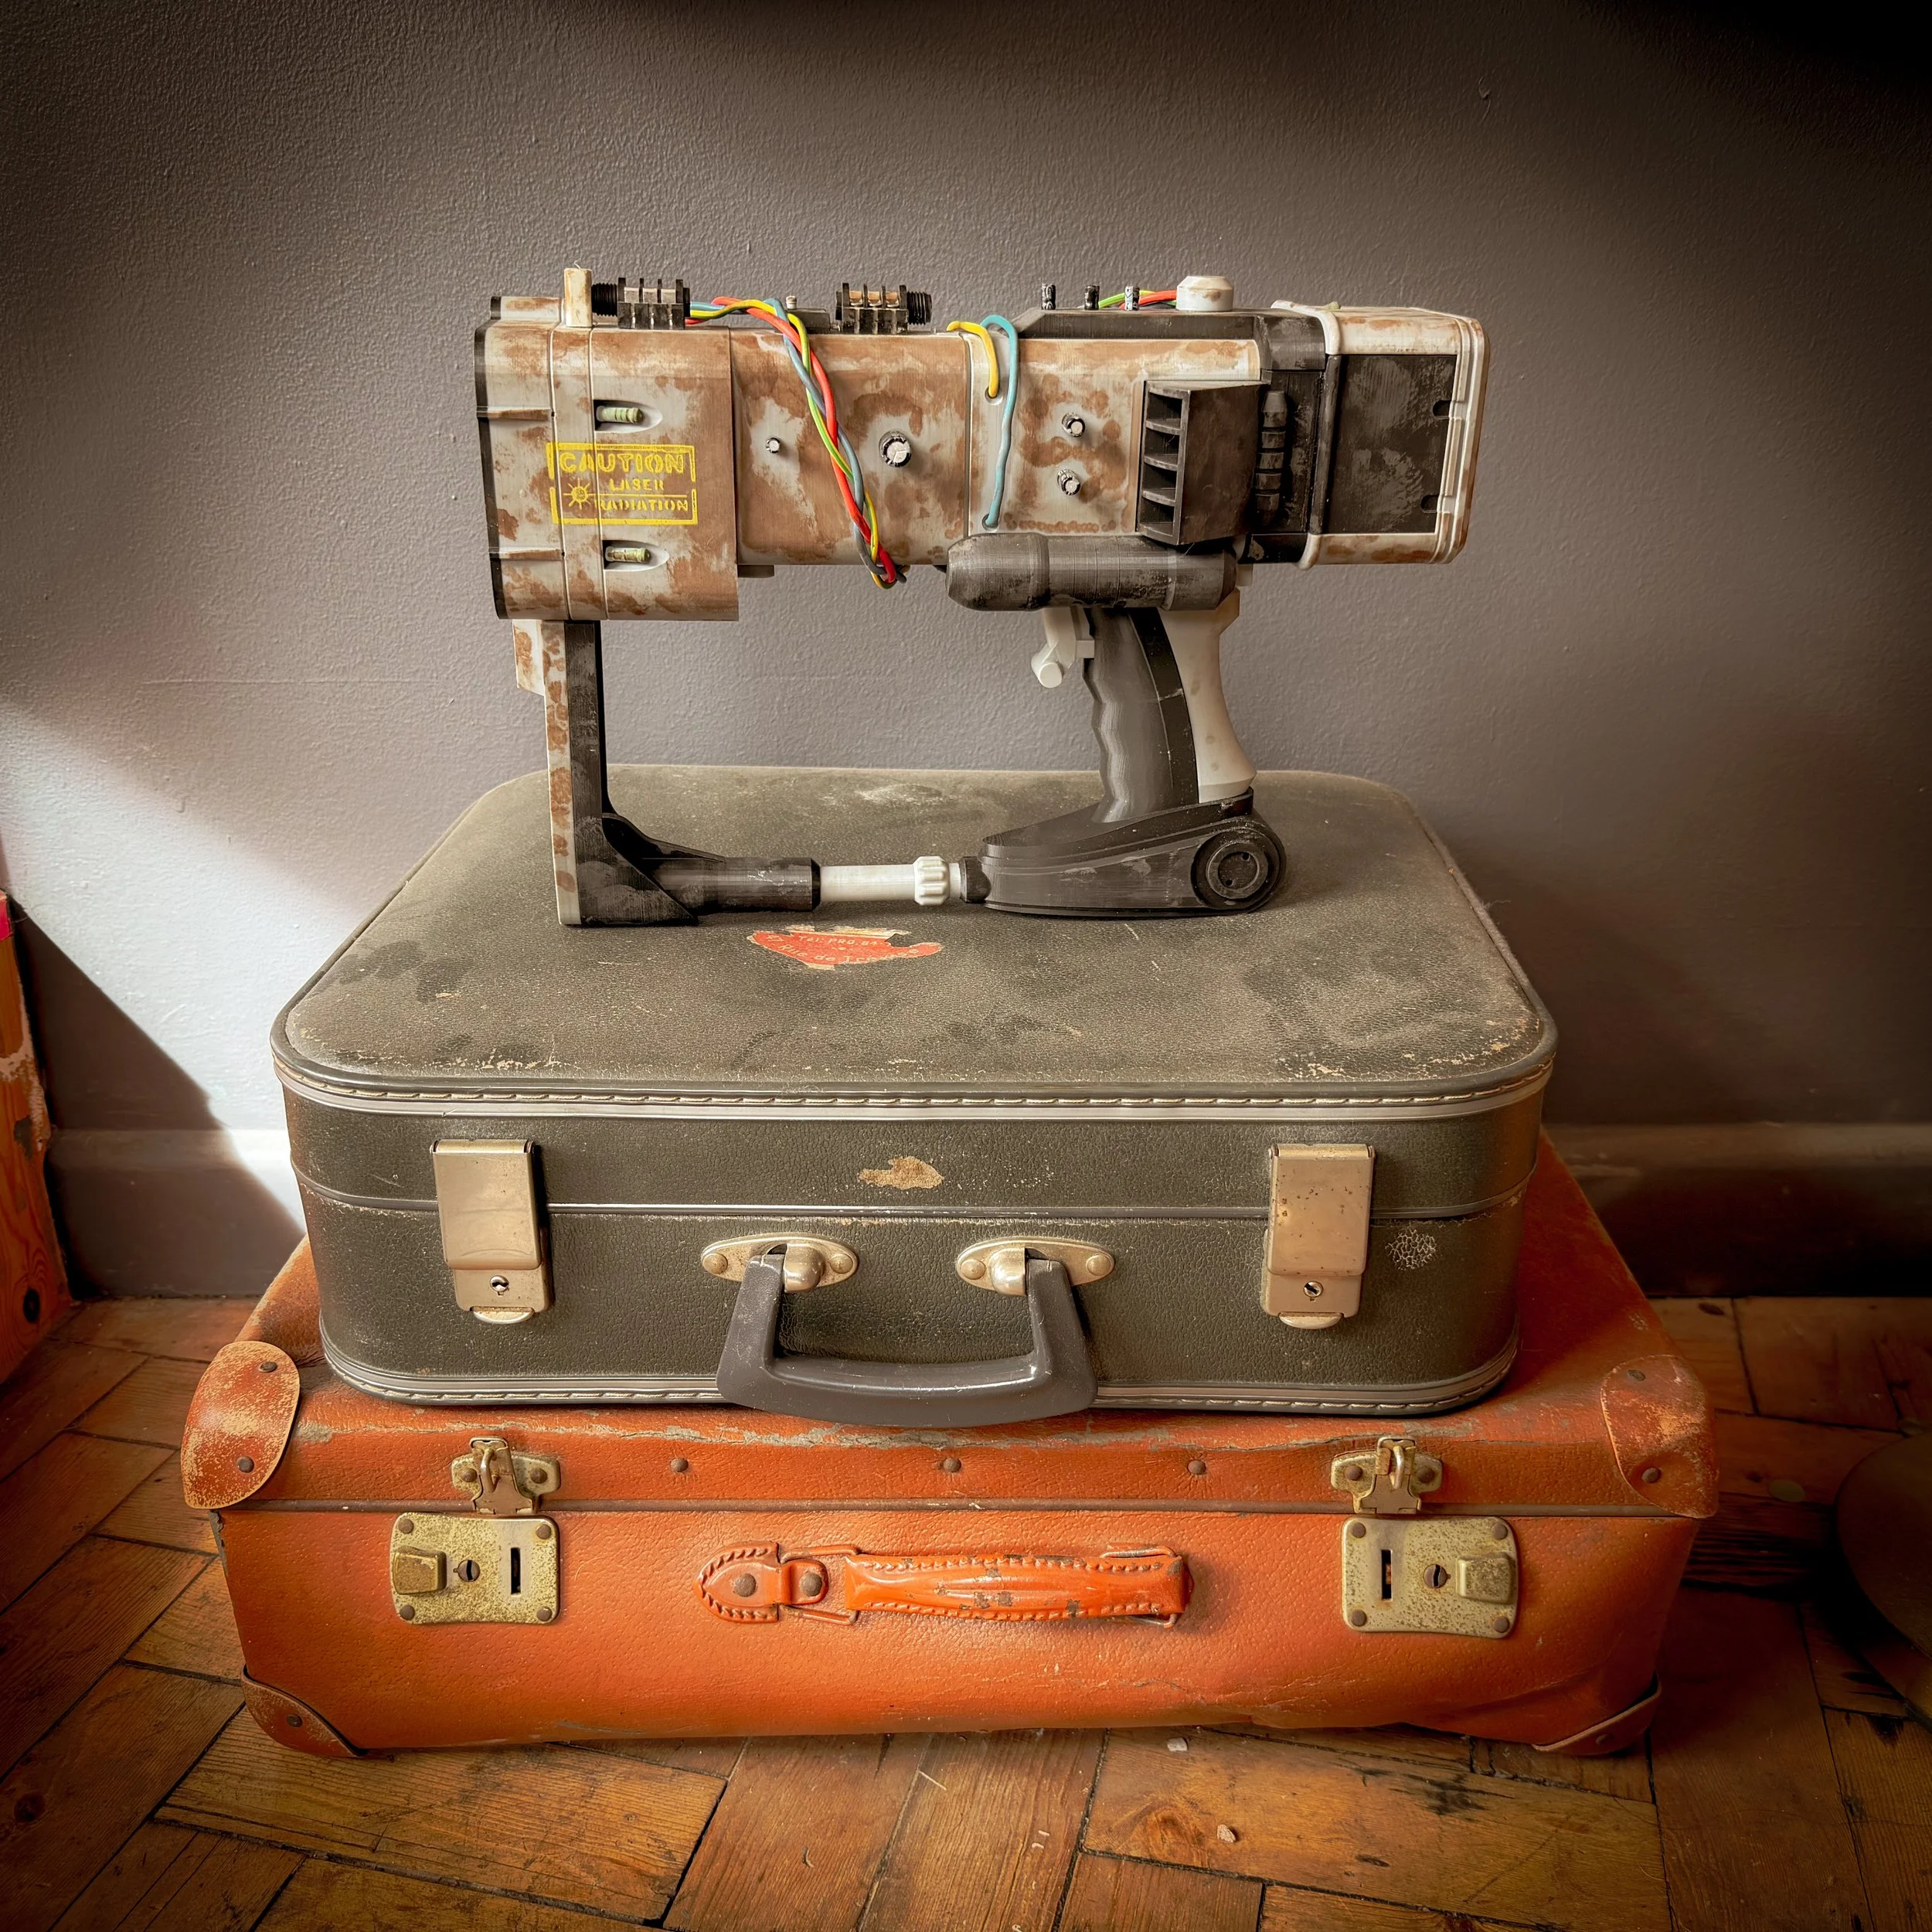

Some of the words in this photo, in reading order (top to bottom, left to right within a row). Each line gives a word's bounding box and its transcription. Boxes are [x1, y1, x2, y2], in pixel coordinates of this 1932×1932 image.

[559, 452, 685, 474] CAUTION
[609, 478, 665, 492] LASER
[594, 498, 689, 512] RADIATION
[779, 944, 808, 957] Rue
[813, 953, 836, 961] de
